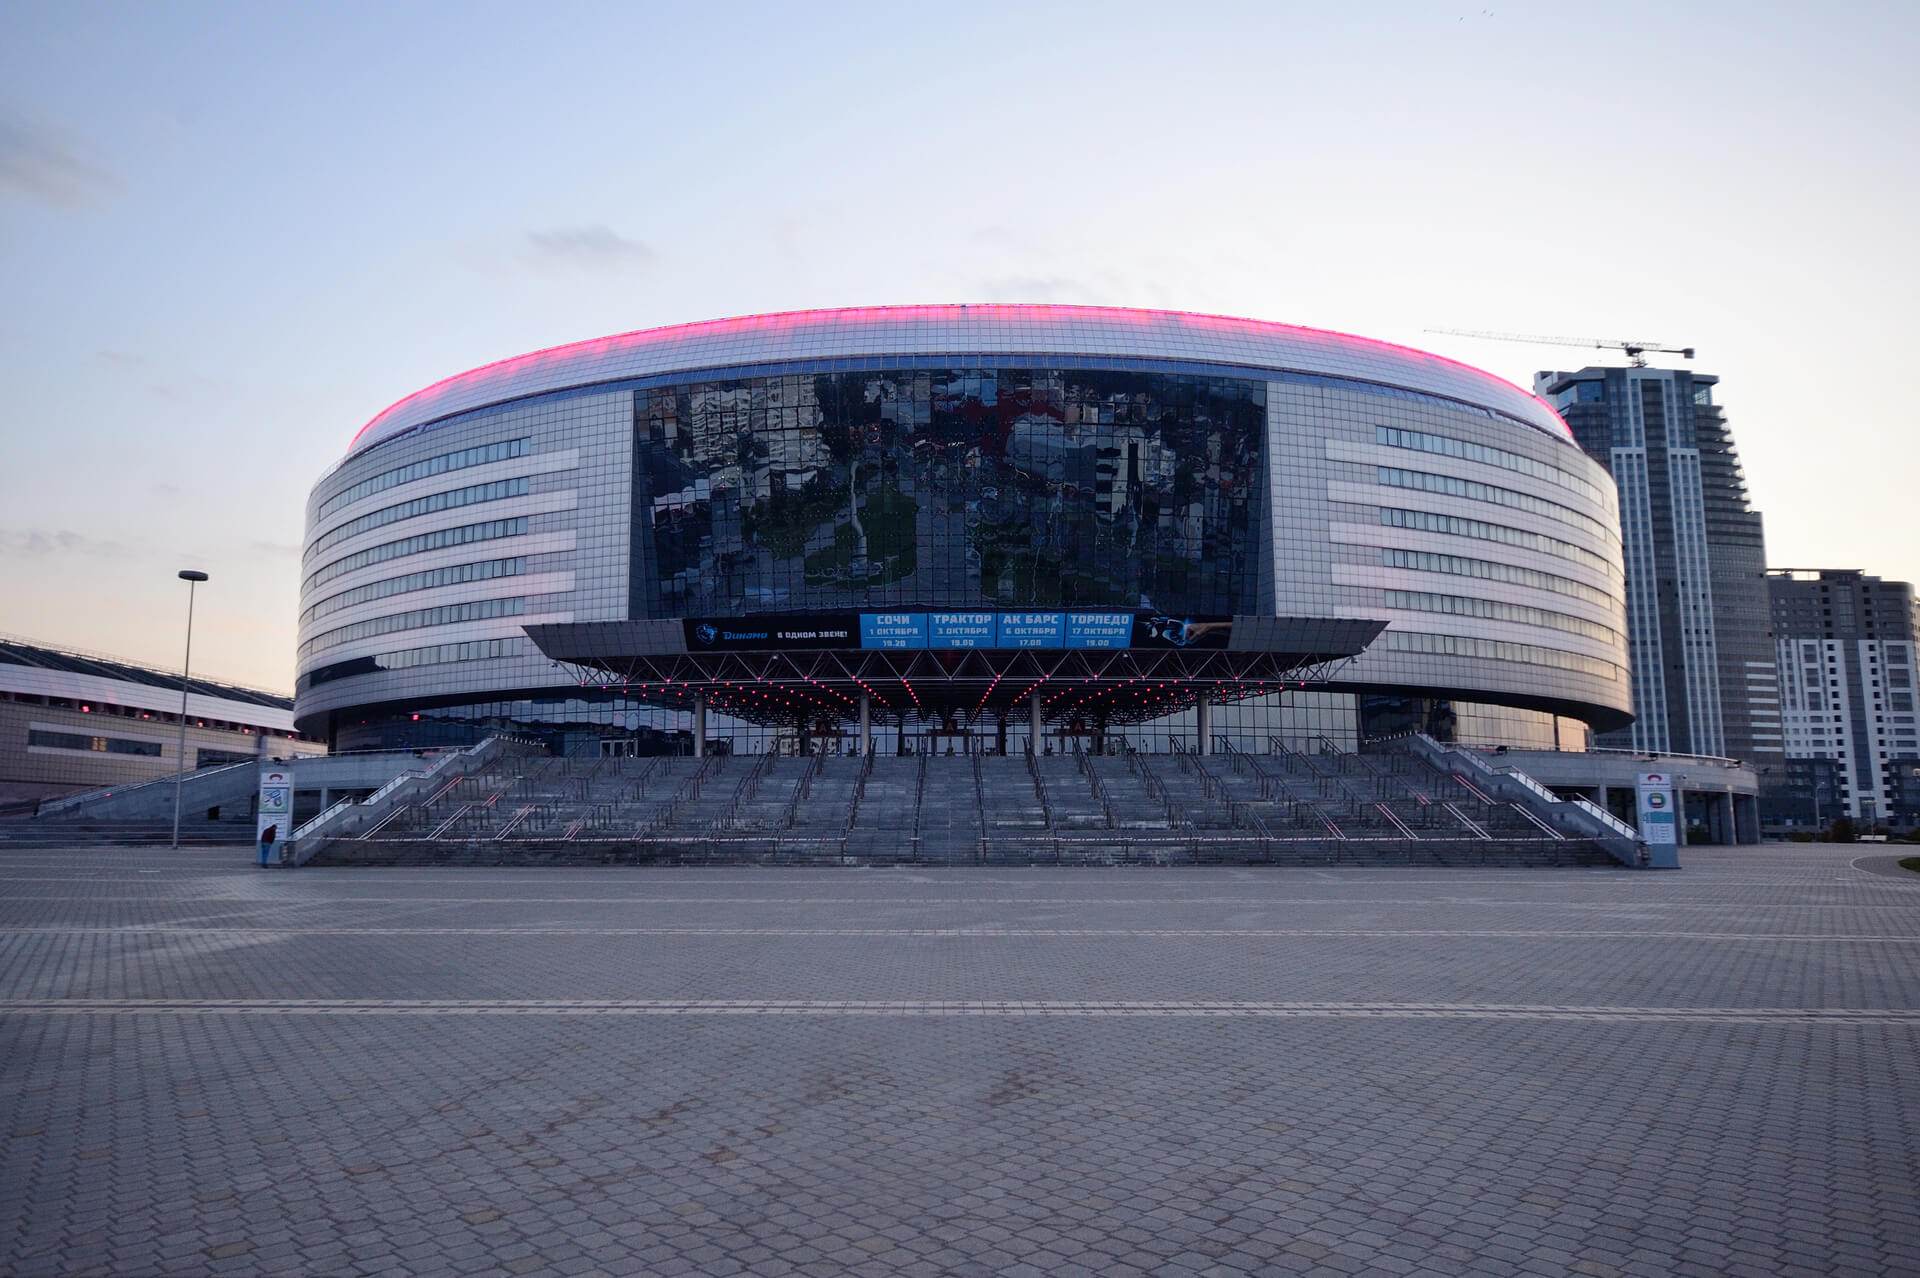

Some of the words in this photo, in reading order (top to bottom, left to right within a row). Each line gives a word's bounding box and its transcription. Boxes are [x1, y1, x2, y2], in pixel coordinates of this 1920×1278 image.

[877, 615, 910, 625] СОЧИ
[933, 615, 992, 624] ТРАКТОР
[1003, 615, 1021, 624] АК
[1025, 615, 1059, 624] БАРС
[1070, 615, 1130, 626] ТОРПЕДО
[785, 631, 816, 639] ОДНОМ
